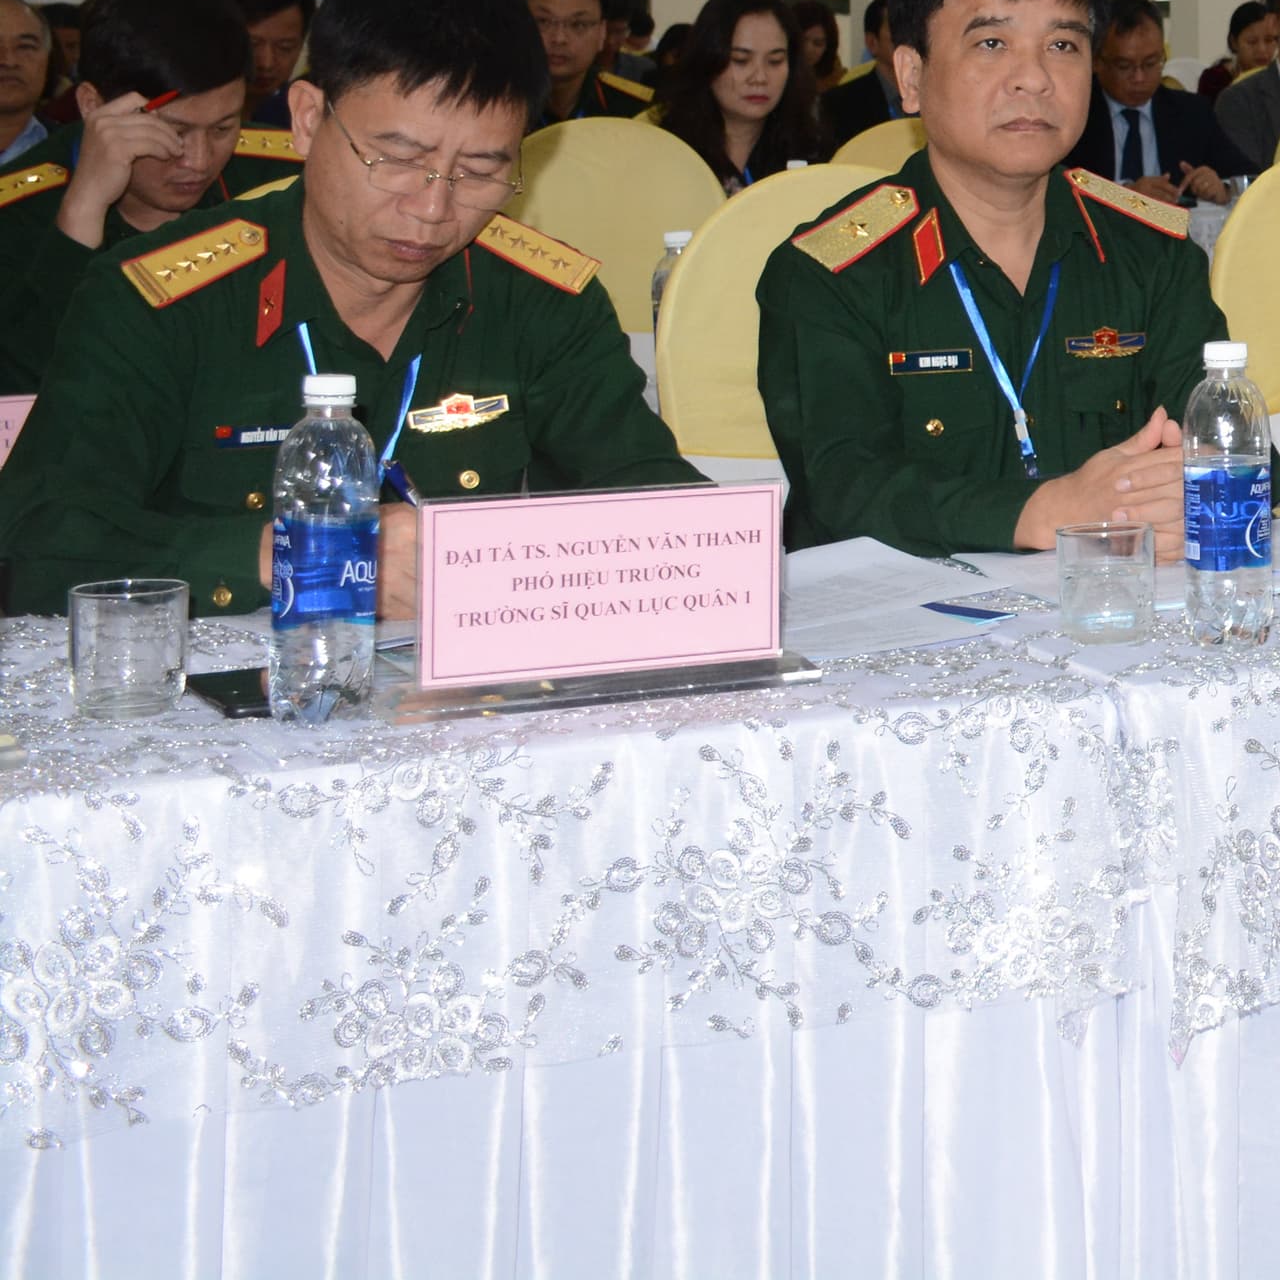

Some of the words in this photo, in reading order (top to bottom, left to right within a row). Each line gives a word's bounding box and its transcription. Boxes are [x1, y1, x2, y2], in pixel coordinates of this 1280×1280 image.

[446, 548, 482, 568] ĐẠI
[488, 542, 516, 563] TÁ
[522, 544, 551, 560] TS.
[557, 534, 641, 557] NGUYỄN
[648, 532, 688, 551] VĂN
[693, 529, 762, 548] THANH
[511, 571, 554, 592] PHÓ
[561, 569, 609, 590] HIỆU
[616, 562, 701, 584] TRƯỞNG
[454, 605, 545, 628] TRƯỜNG
[551, 601, 569, 620] SĨ
[574, 599, 631, 621] QUAN
[638, 596, 678, 616] LỤC
[683, 588, 738, 611] QUÂN
